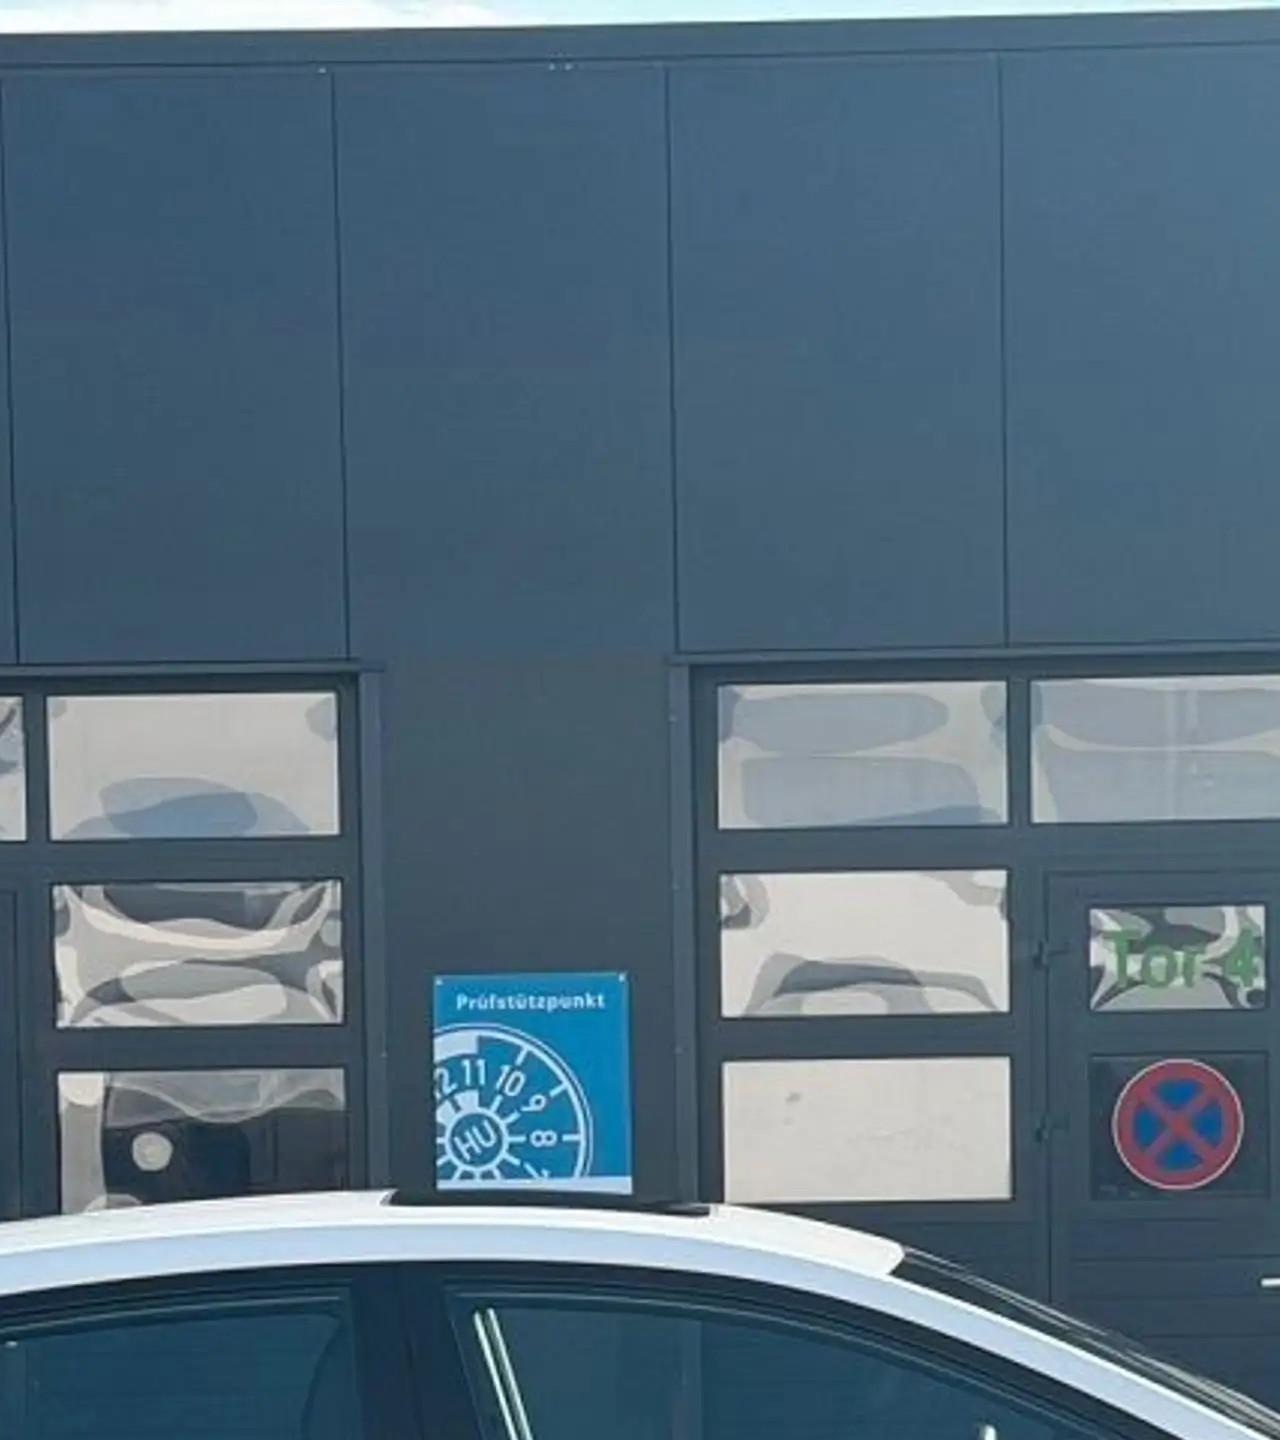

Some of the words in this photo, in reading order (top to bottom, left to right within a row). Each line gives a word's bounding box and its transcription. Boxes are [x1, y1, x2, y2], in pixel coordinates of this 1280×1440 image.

[1103, 929, 1206, 989] Tor
[1223, 929, 1259, 988] 4
[456, 993, 606, 1014] Prüfstützpunkt
[462, 1058, 486, 1085] 11
[496, 1064, 527, 1097] 10
[454, 1119, 497, 1161] HU
[530, 1130, 557, 1146] 8
